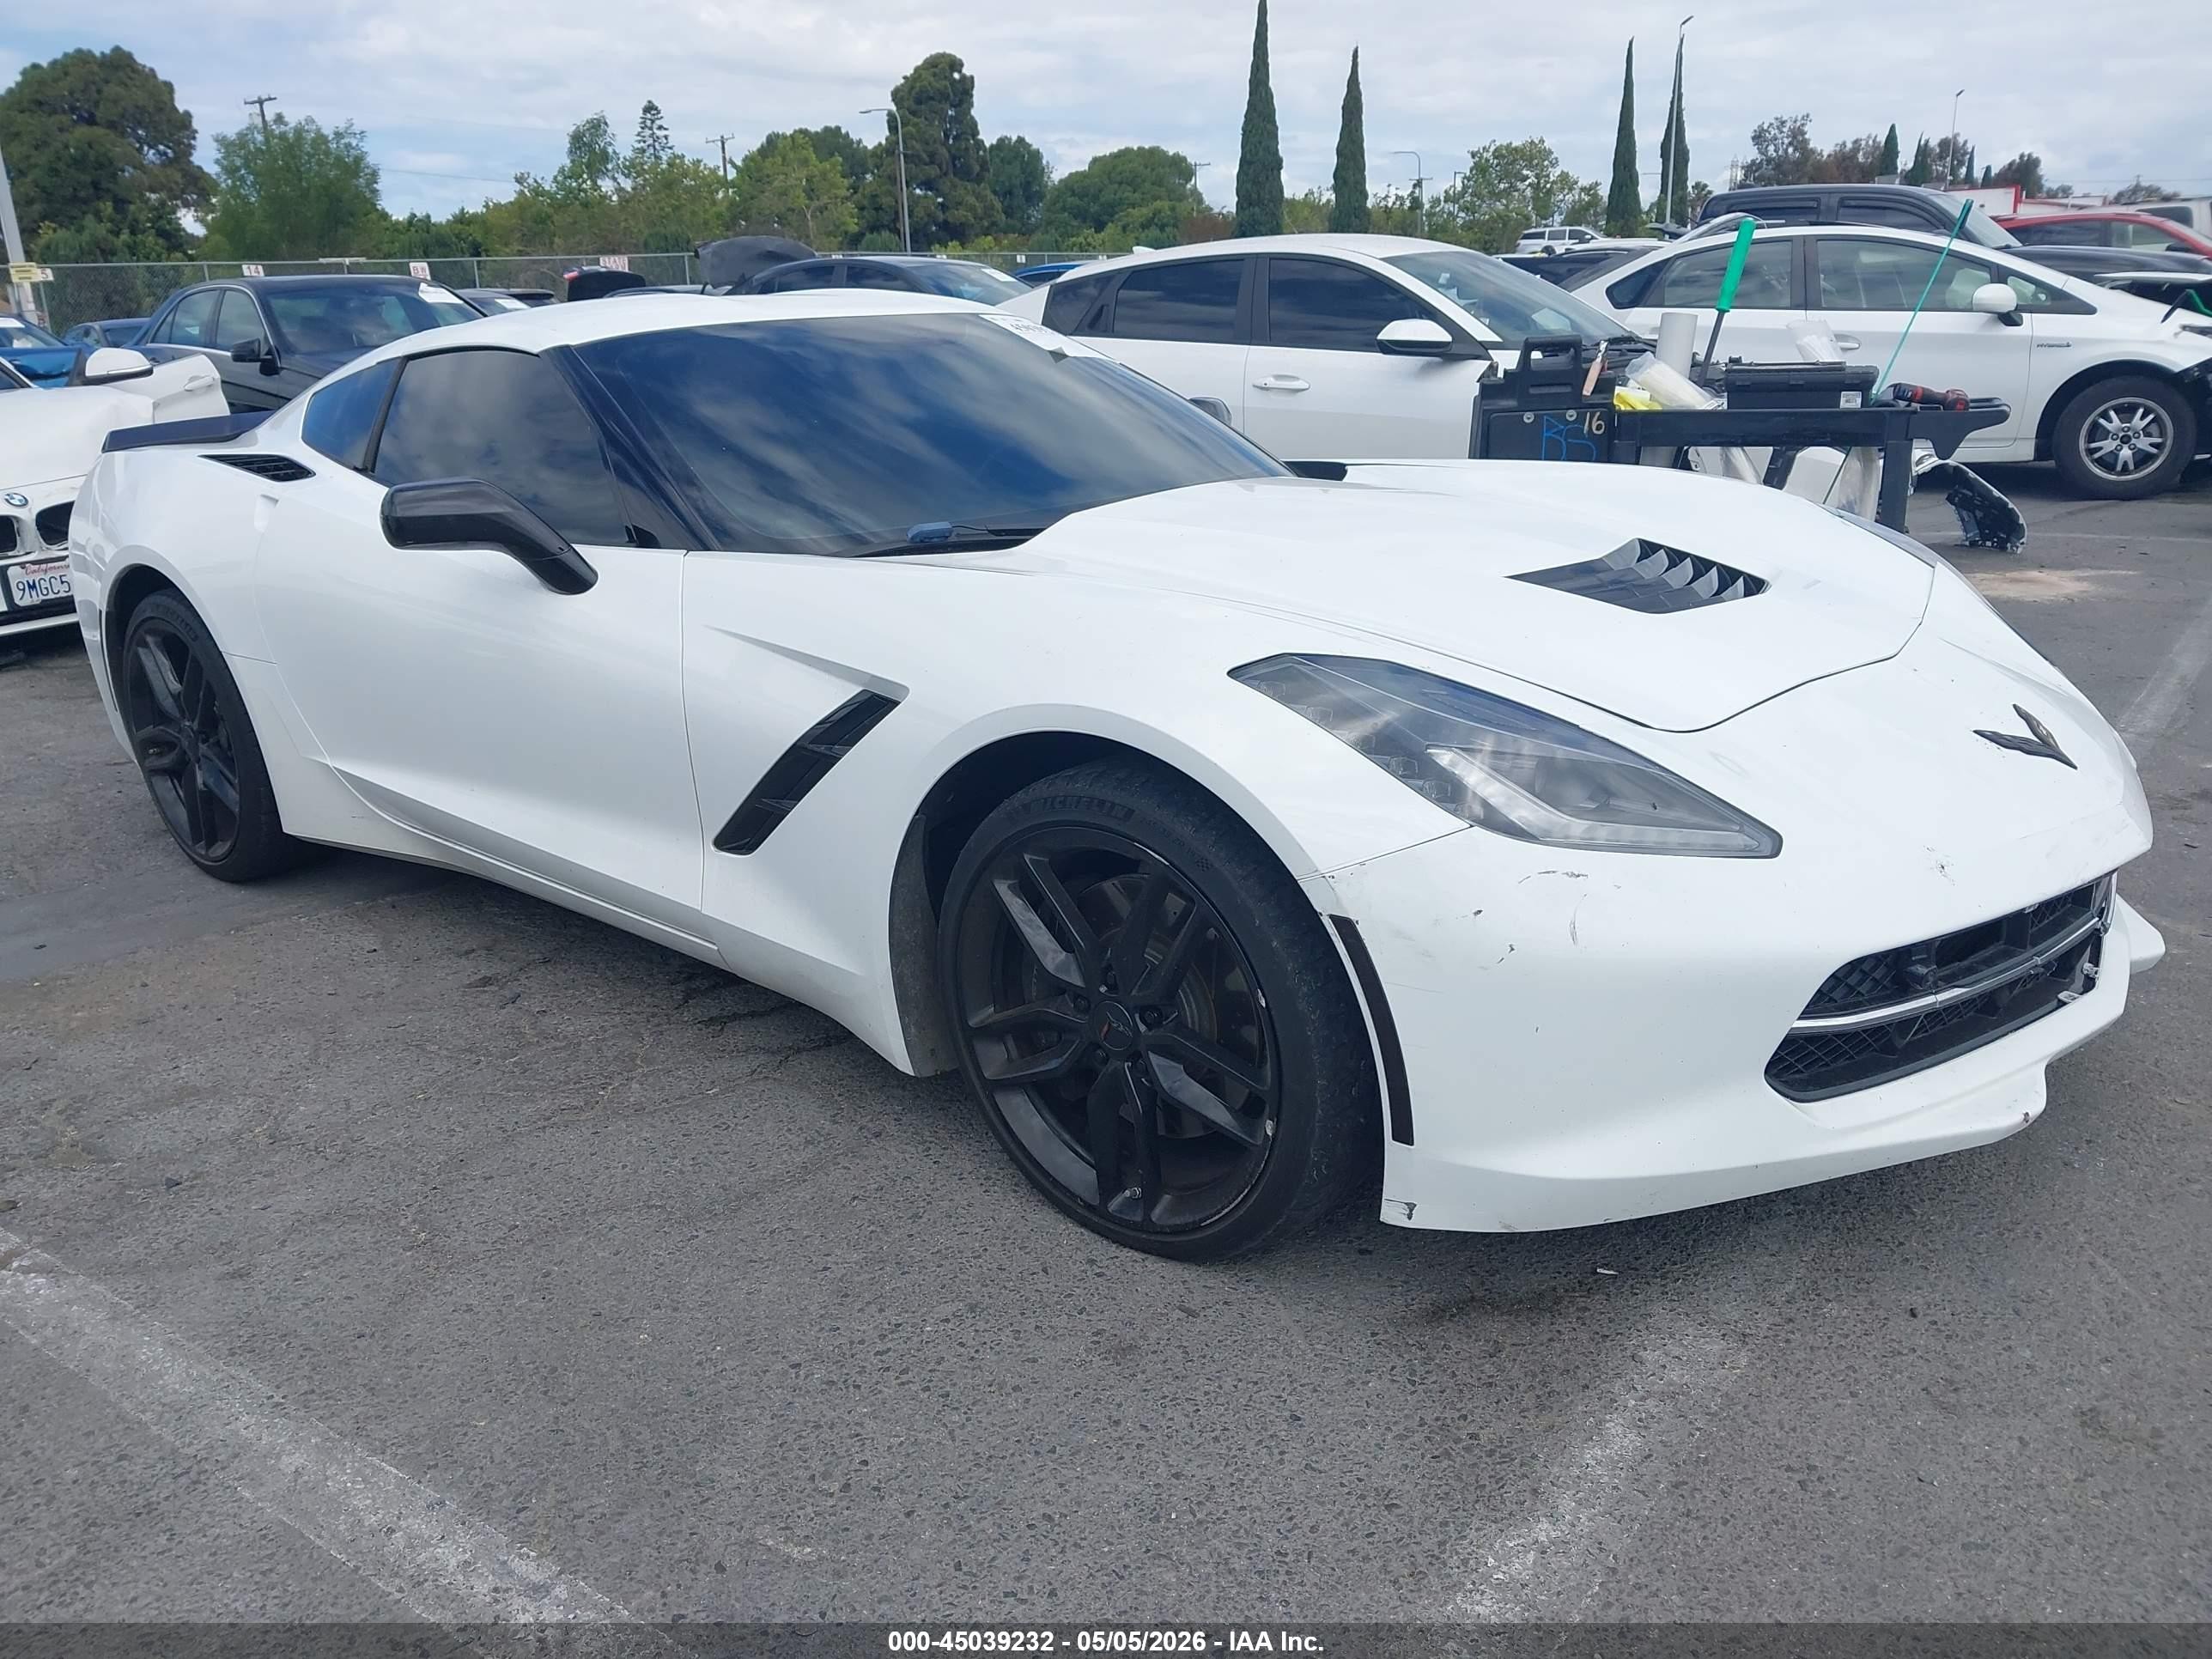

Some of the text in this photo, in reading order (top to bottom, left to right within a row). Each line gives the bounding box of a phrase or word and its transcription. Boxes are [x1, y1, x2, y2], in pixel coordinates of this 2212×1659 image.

[1583, 411, 1605, 434] 16
[26, 563, 70, 574] Californi
[16, 574, 71, 600] 9MGC5
[1030, 795, 1135, 821] MICHELIN
